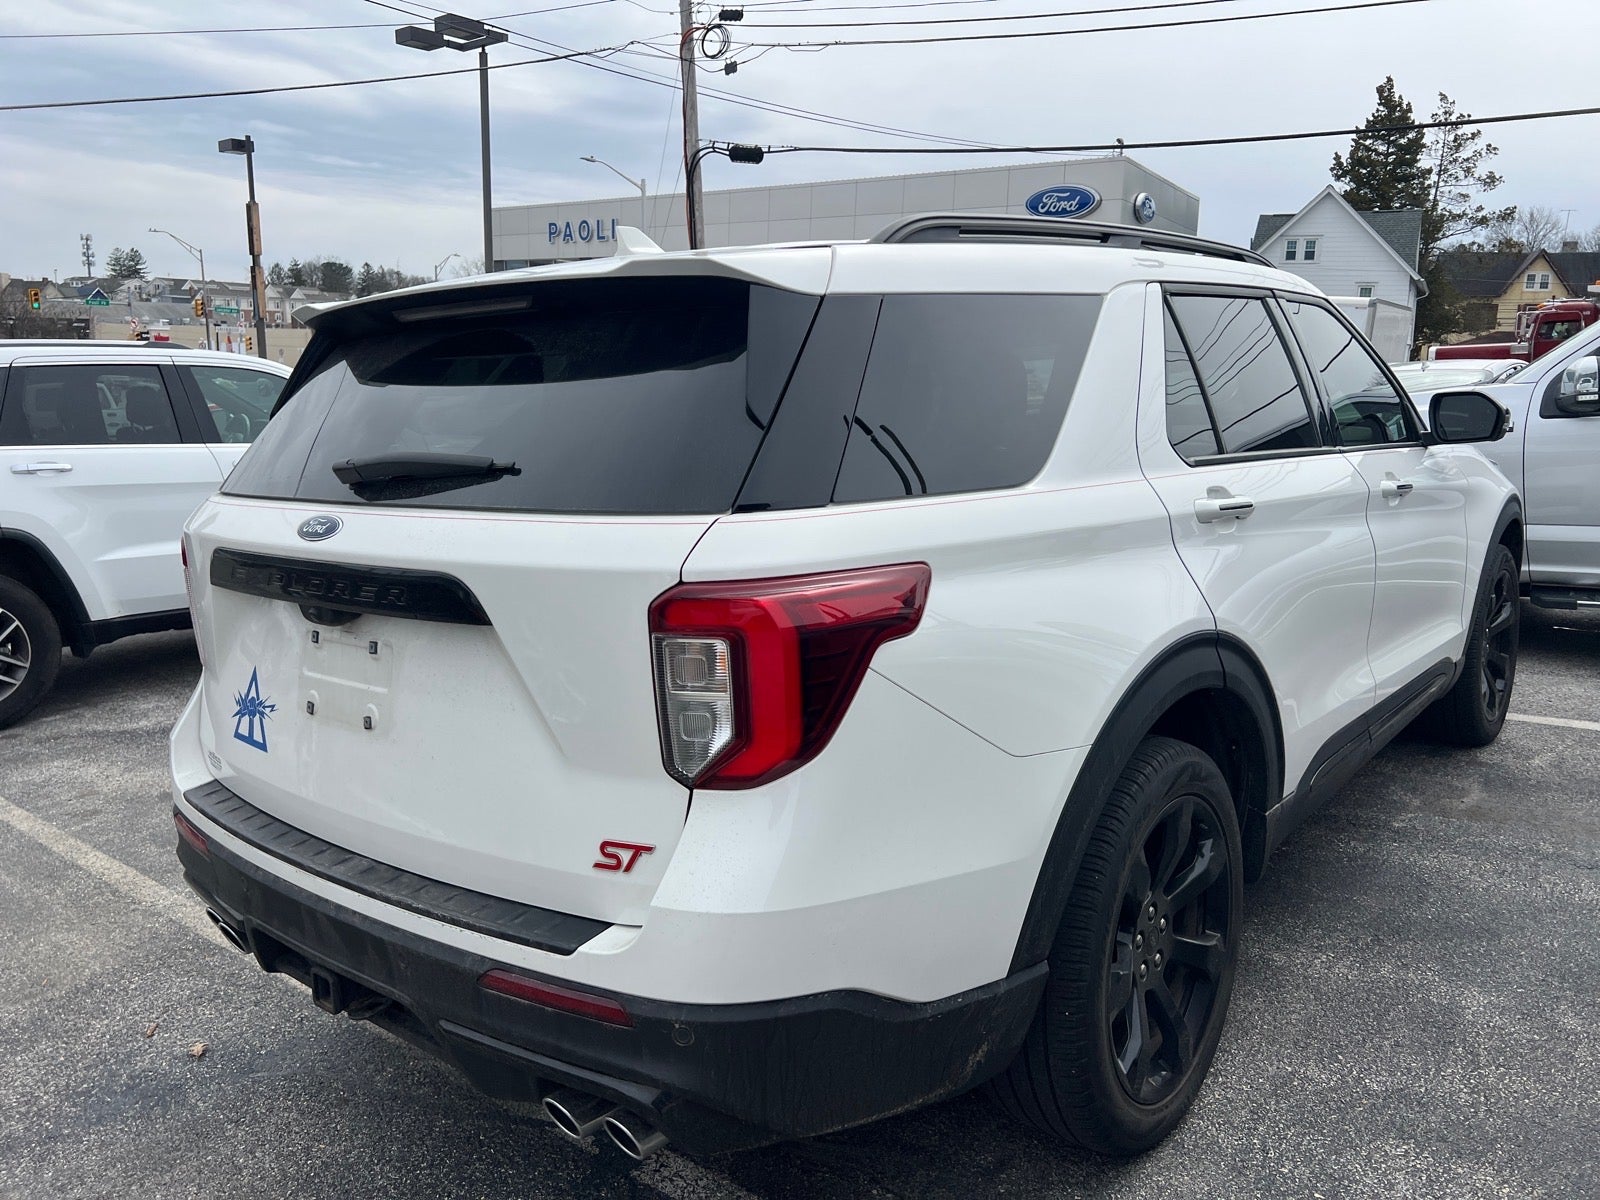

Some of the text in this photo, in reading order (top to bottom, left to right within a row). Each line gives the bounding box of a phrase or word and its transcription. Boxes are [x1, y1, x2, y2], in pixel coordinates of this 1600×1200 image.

[1037, 192, 1081, 213] Ford
[547, 218, 618, 243] PAOLI
[303, 518, 331, 533] Ford
[231, 564, 407, 606] EPLORER
[592, 839, 656, 873] ST
